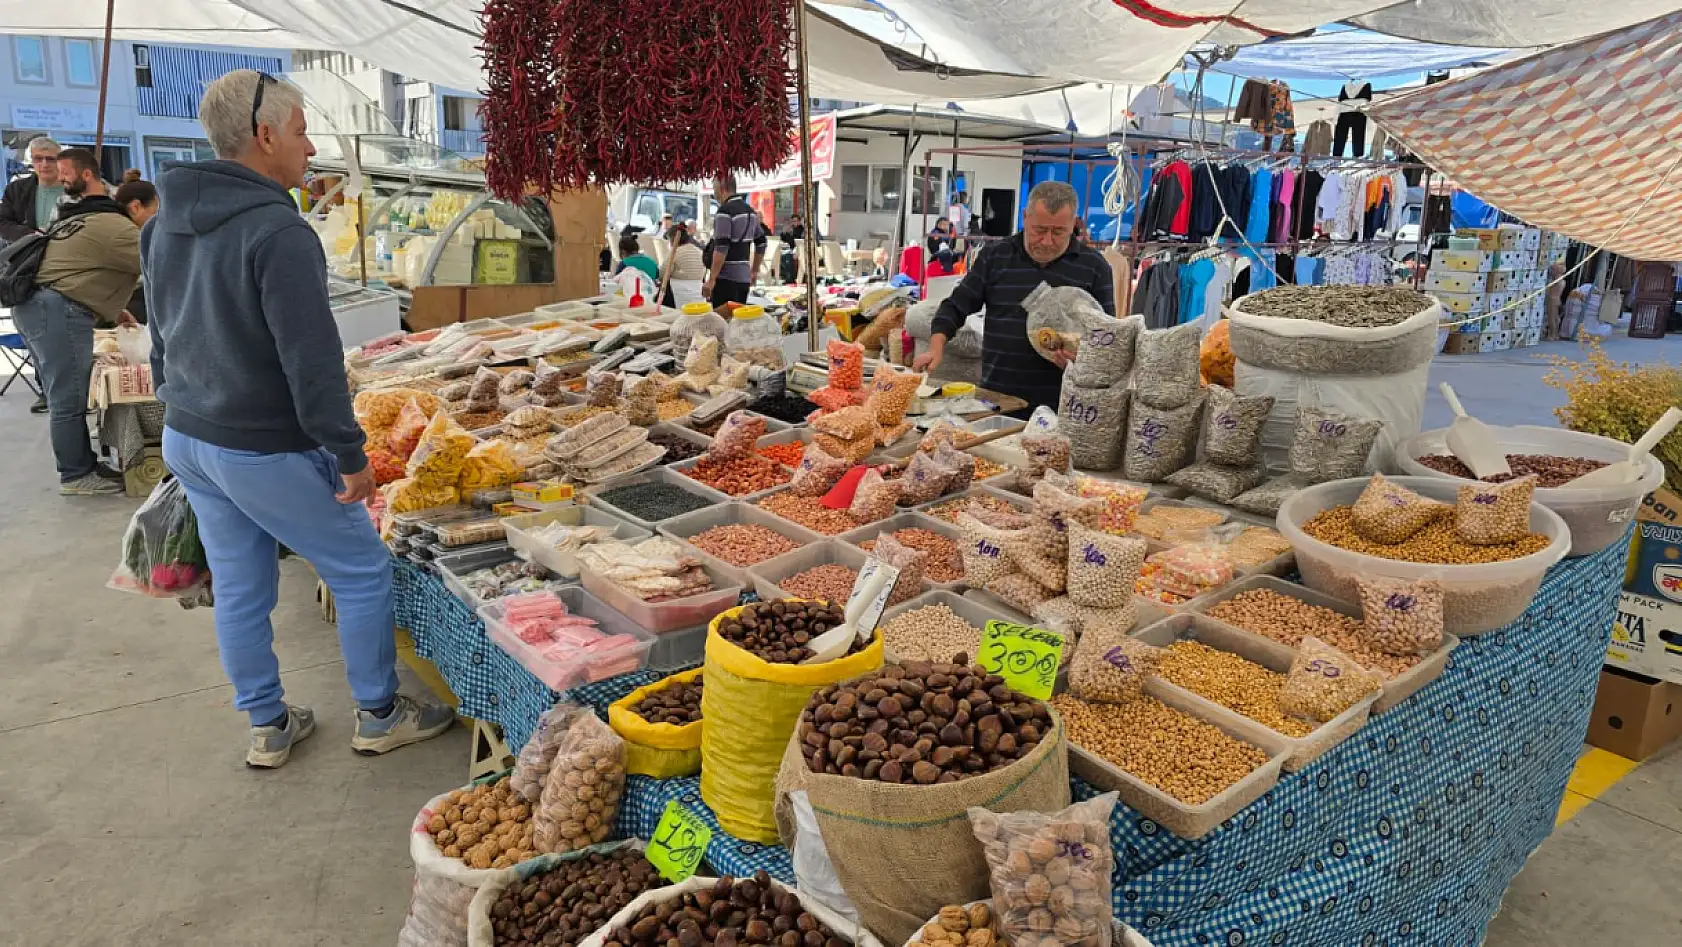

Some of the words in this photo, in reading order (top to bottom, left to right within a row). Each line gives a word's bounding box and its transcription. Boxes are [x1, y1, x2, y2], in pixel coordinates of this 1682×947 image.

[1088, 328, 1115, 348] 50
[1066, 392, 1098, 424] 100
[1318, 419, 1346, 437] 100
[1633, 597, 1664, 611] PACK
[985, 642, 1057, 676] 300
[1304, 659, 1341, 678] 50
